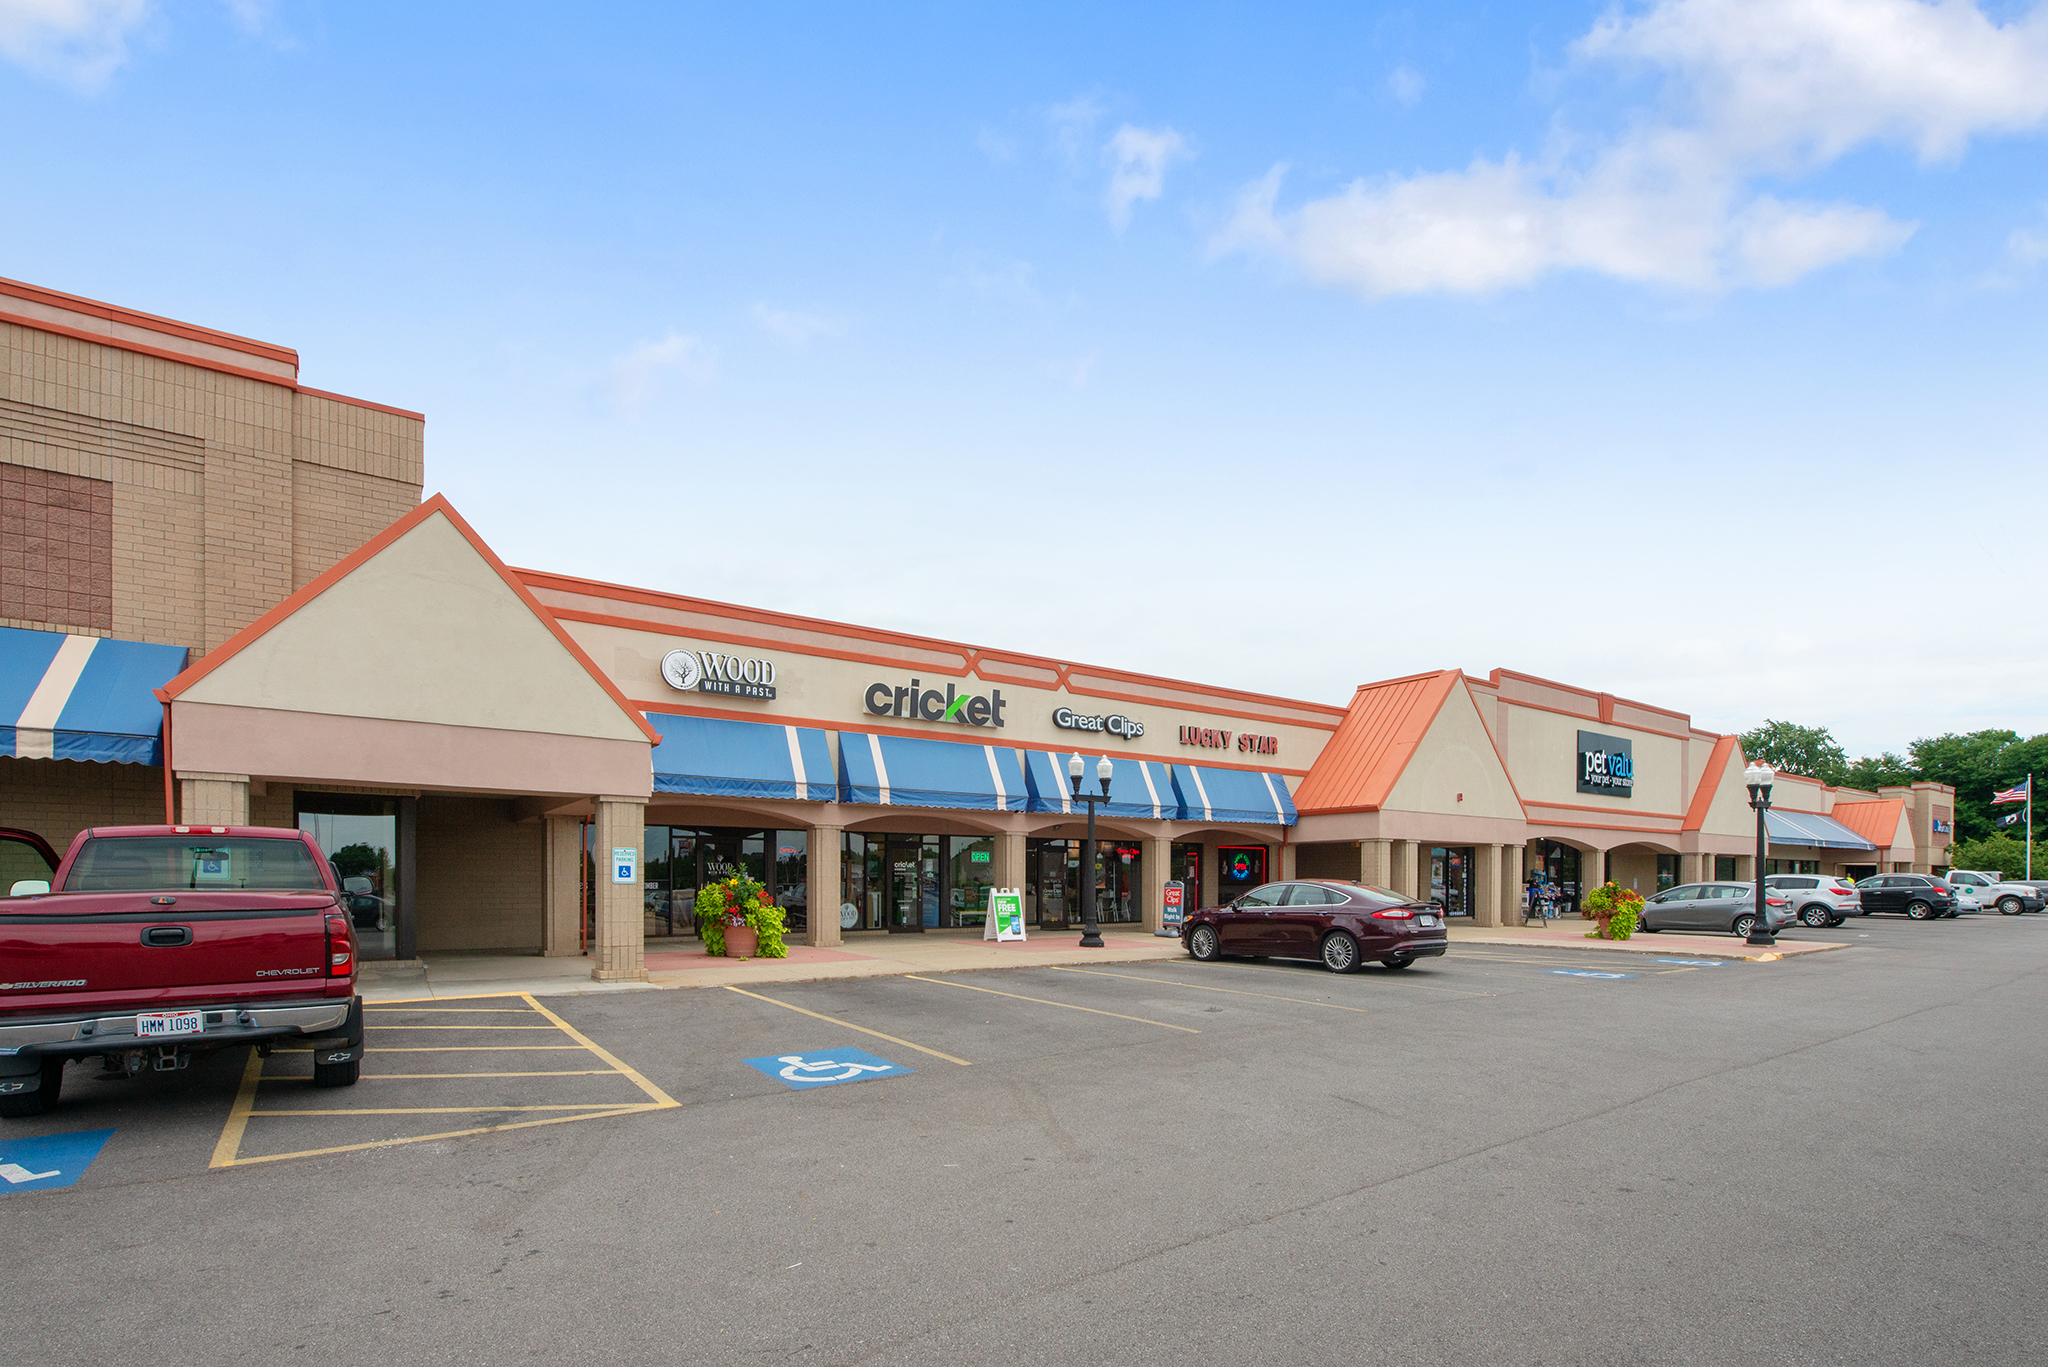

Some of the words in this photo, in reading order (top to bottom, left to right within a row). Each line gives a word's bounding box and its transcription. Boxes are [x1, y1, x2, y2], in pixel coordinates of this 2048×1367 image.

[696, 650, 776, 685] WOOD
[704, 680, 730, 692] WITH
[735, 684, 741, 694] A
[746, 685, 769, 697] PAST
[864, 678, 1006, 728] cricket
[1055, 708, 1104, 731] Great
[1107, 715, 1144, 738] Clips
[1179, 725, 1233, 749] LUCKY
[1238, 733, 1278, 754] STAR
[1585, 749, 1607, 780] pet
[1607, 752, 1634, 777] valu
[1590, 774, 1601, 785] your
[1602, 775, 1610, 786] pet
[1612, 777, 1622, 787] your
[971, 852, 990, 861] OPEN
[1165, 889, 1180, 897] Great
[997, 903, 1017, 912] FREE
[256, 967, 320, 977] CHEVROLET
[13, 979, 87, 989] SILVERADO
[141, 1019, 165, 1033] HMM
[169, 1017, 198, 1031] 1098
